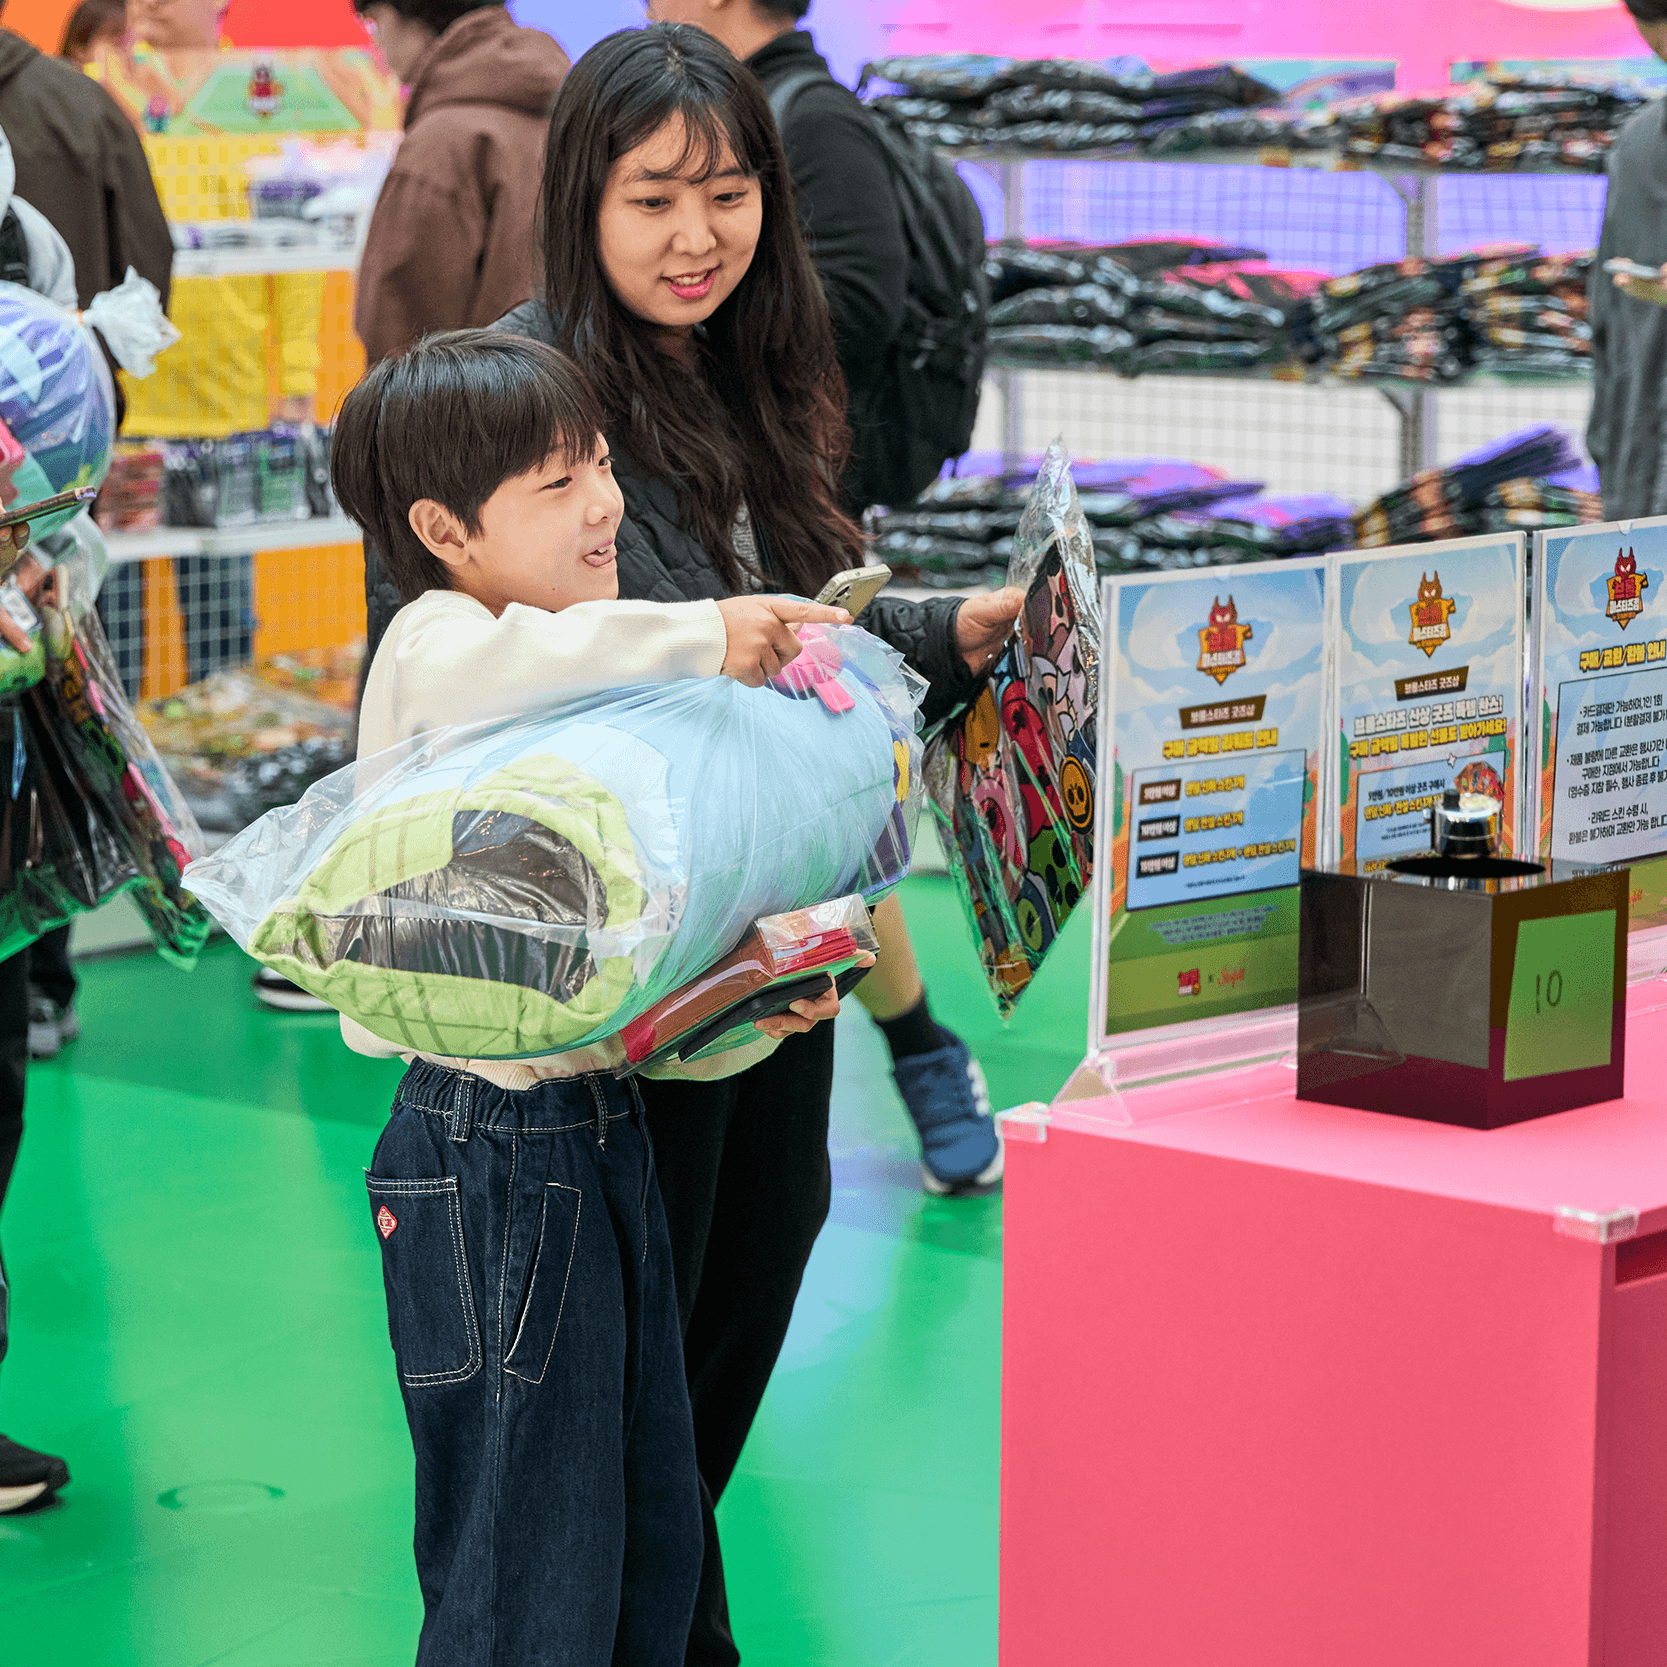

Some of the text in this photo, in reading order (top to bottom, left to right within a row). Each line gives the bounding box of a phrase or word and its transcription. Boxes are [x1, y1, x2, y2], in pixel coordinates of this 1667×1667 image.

[1579, 639, 1666, 672] 구매/교환/환불 안내
[1404, 675, 1460, 694] 브롤스타즈 굿즈샵
[1190, 706, 1230, 724] 브롤스타즈
[1354, 708, 1407, 737] 브롤스타즈
[1408, 705, 1431, 728] 신상
[1432, 701, 1454, 725] 굿즈
[1478, 694, 1503, 717] 찬스!
[1583, 702, 1615, 718] 카드결제만
[1576, 722, 1590, 736] 결제
[1591, 716, 1622, 733] 가능합니다
[1350, 739, 1370, 760] 구매
[1459, 717, 1507, 742] 받아가세요!
[1619, 743, 1638, 758] 교환은
[1602, 761, 1628, 777] 지점에서
[1629, 755, 1660, 771] 가능합니다
[1591, 781, 1604, 794] 지참
[1635, 773, 1648, 787] 종료
[1591, 808, 1610, 824] 리워드
[1612, 806, 1625, 820] 스킨
[1626, 803, 1639, 817] 수령
[1568, 829, 1588, 845] 환불은
[1589, 824, 1615, 841] 불가하며
[1636, 818, 1649, 831] 가능
[1536, 969, 1563, 1014] 10
